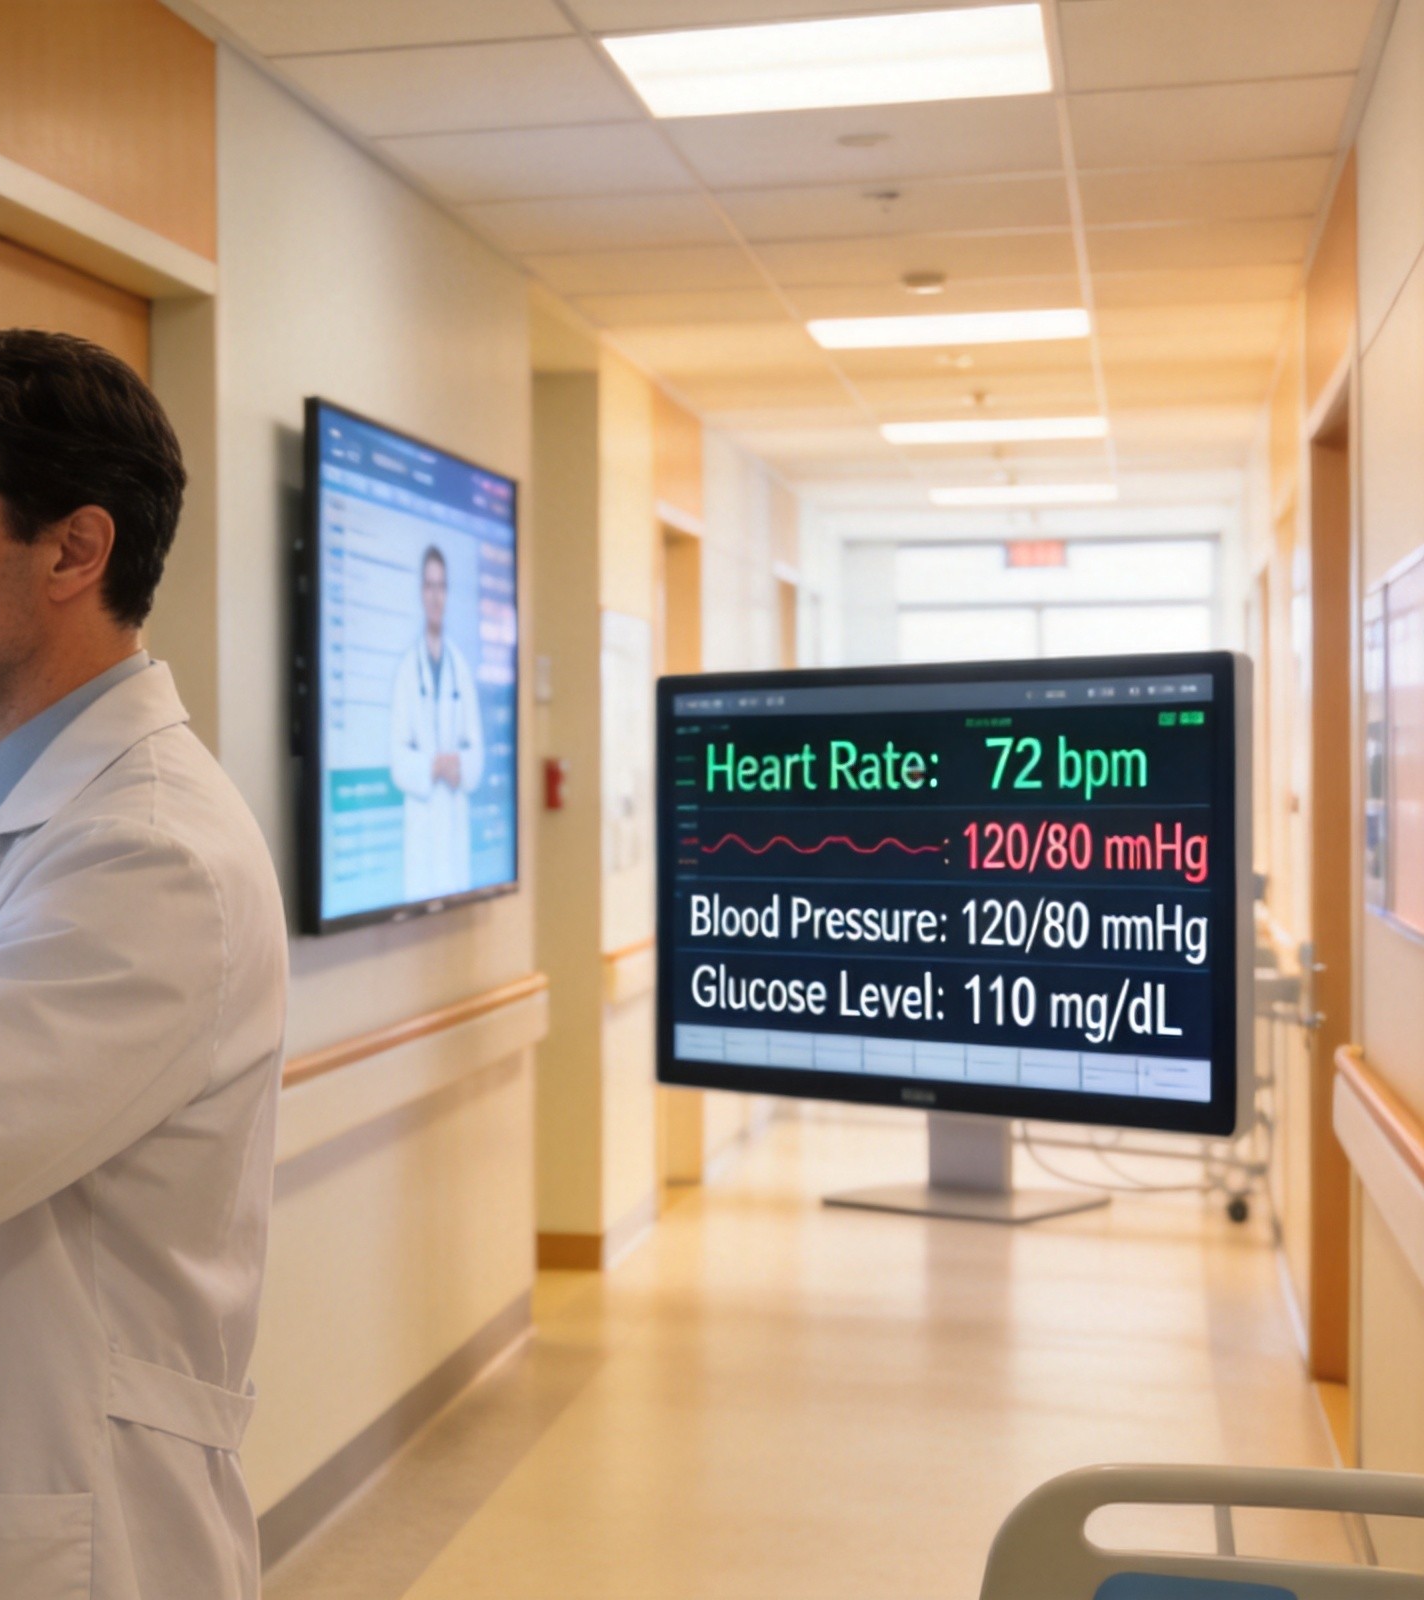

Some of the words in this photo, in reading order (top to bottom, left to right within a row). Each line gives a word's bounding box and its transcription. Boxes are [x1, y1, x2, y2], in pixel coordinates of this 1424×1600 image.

[705, 742, 817, 794] Heart
[829, 739, 940, 791] Rate:
[985, 737, 1042, 790] 72
[1058, 735, 1148, 800] bpm
[962, 820, 1092, 873] 120/80
[690, 894, 780, 939] Blood
[790, 897, 948, 944] Pressure:
[961, 896, 1090, 954] 120/80
[690, 964, 827, 1015] Glucose
[838, 970, 945, 1021] Level:
[964, 976, 1037, 1028] 110
[1050, 978, 1182, 1044] mg/dL
